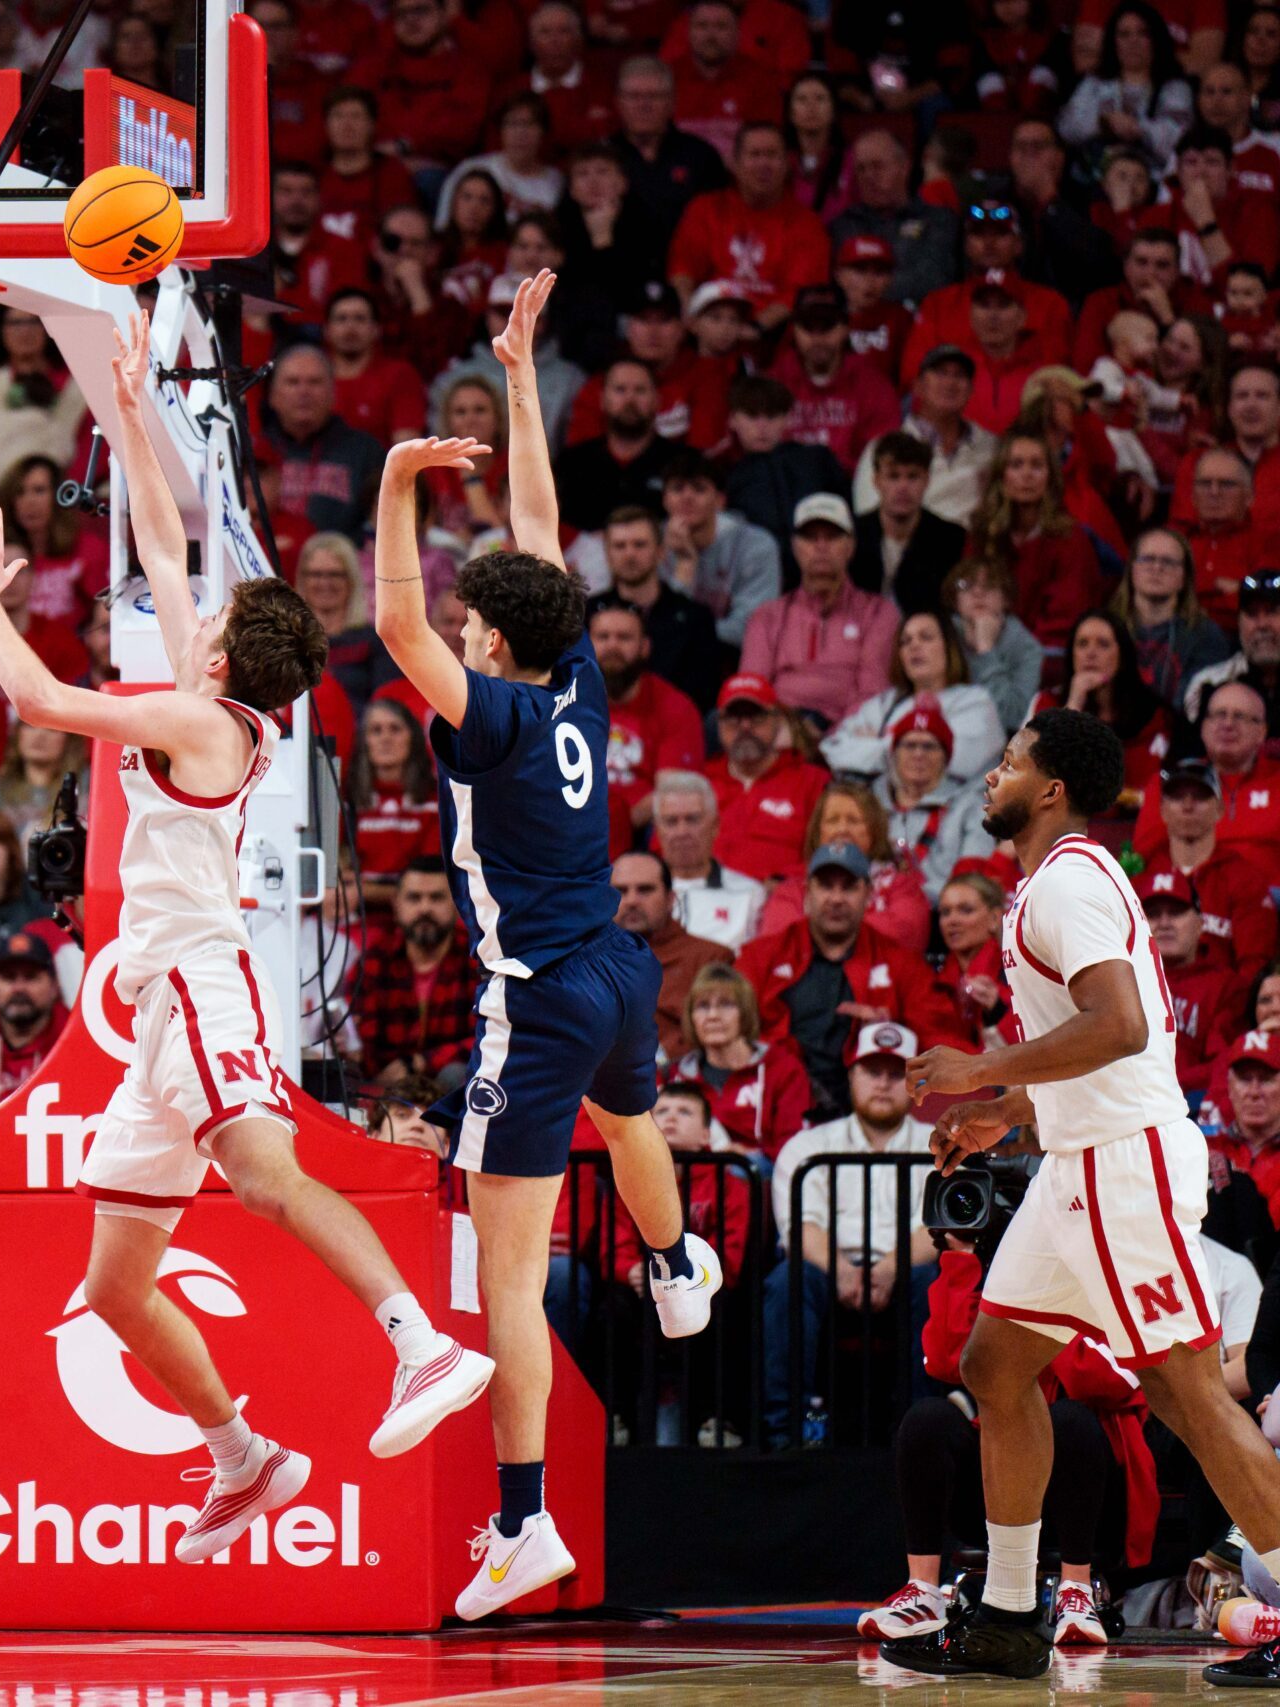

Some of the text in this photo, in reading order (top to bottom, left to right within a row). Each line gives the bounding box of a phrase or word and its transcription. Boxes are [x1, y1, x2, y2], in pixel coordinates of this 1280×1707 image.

[555, 722, 593, 809] 9
[1152, 873, 1174, 892] N
[1243, 1030, 1270, 1051] N
[216, 1049, 264, 1083] N
[1131, 1273, 1185, 1324] N
